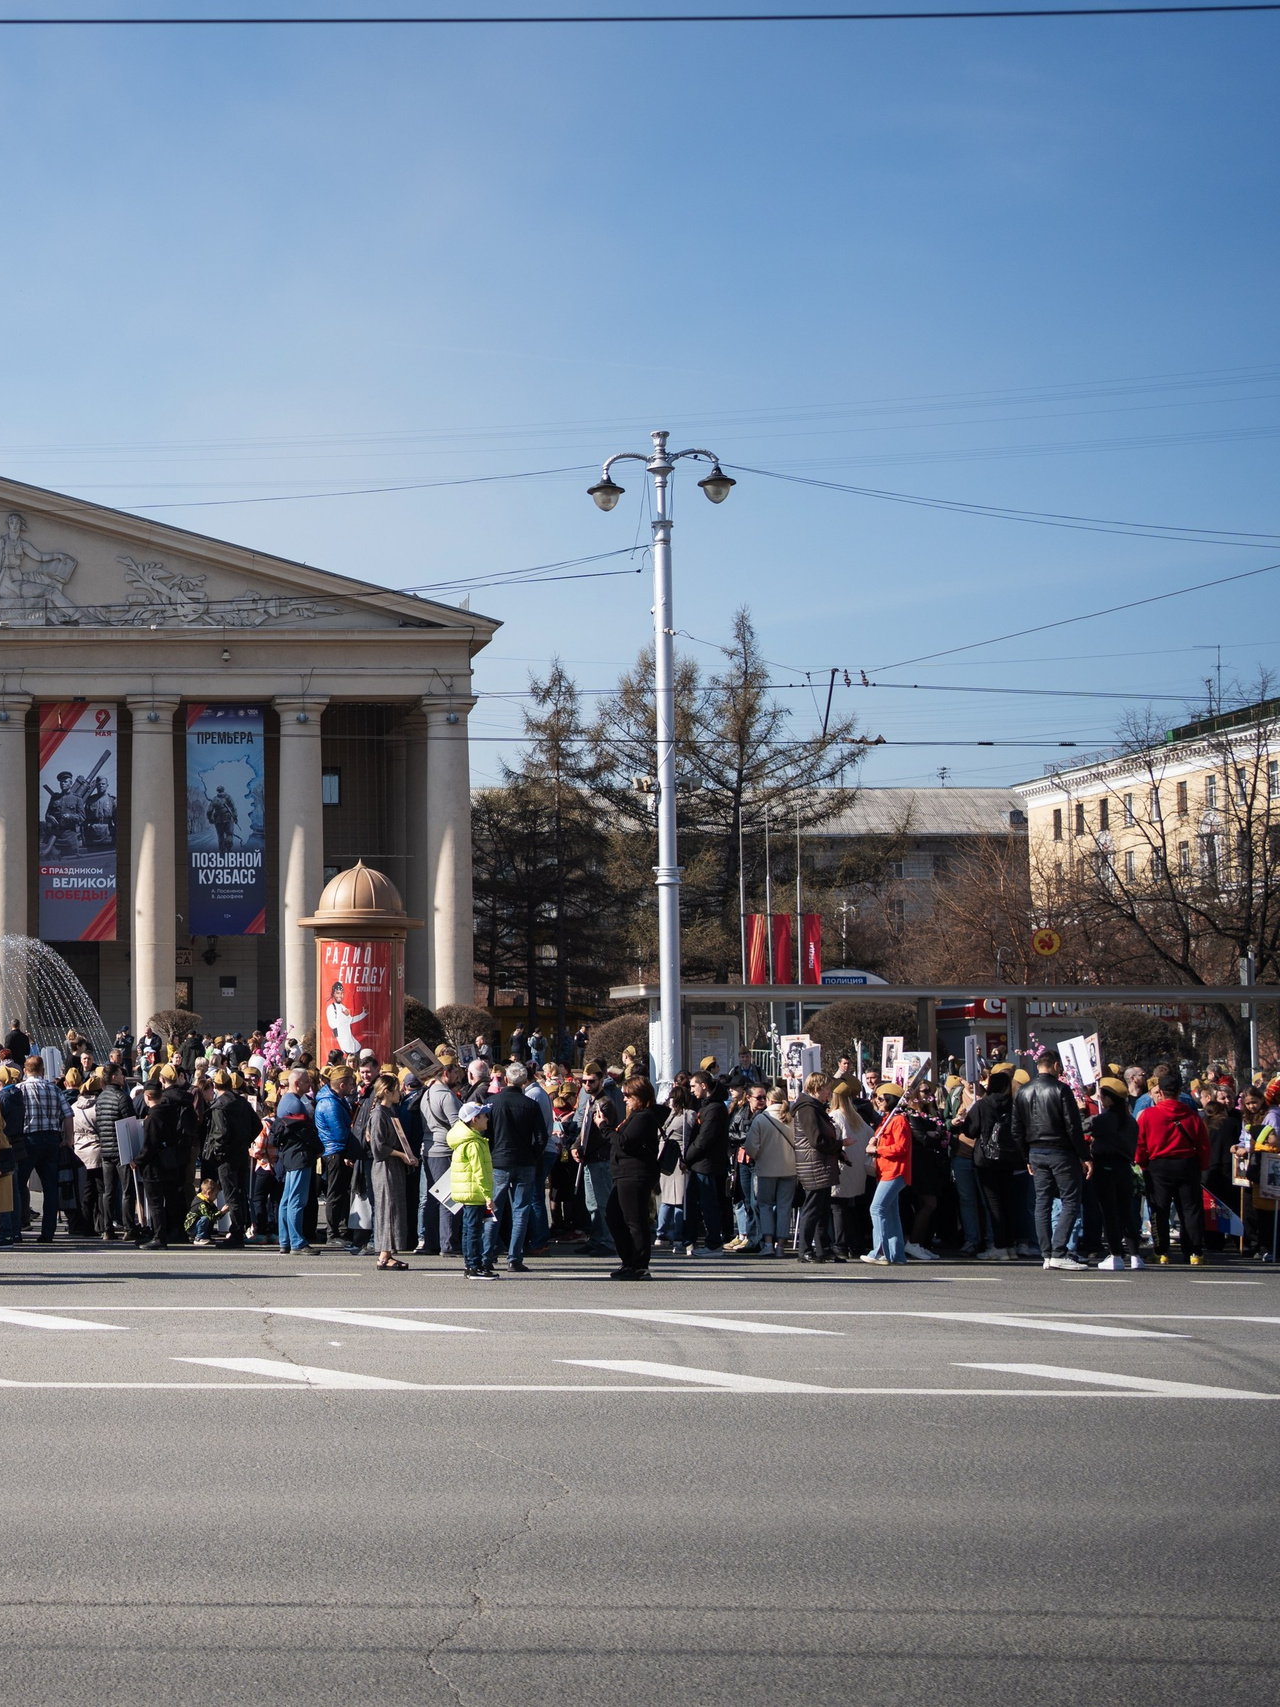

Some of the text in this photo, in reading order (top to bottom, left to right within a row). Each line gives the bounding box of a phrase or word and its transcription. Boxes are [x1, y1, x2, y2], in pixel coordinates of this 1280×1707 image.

[197, 731, 254, 745] ПРЕМЬЕРА
[192, 849, 262, 868] ПОЗЫВНОЙ
[49, 867, 103, 875] ПРАЗДНИКОМ
[199, 869, 256, 885] КУЗБАСС
[53, 874, 116, 888] ВЕЛИКОЙ
[45, 889, 108, 902] ПОБЕДЫ!
[325, 946, 372, 966] РАДИО
[338, 966, 386, 984] ENERGY
